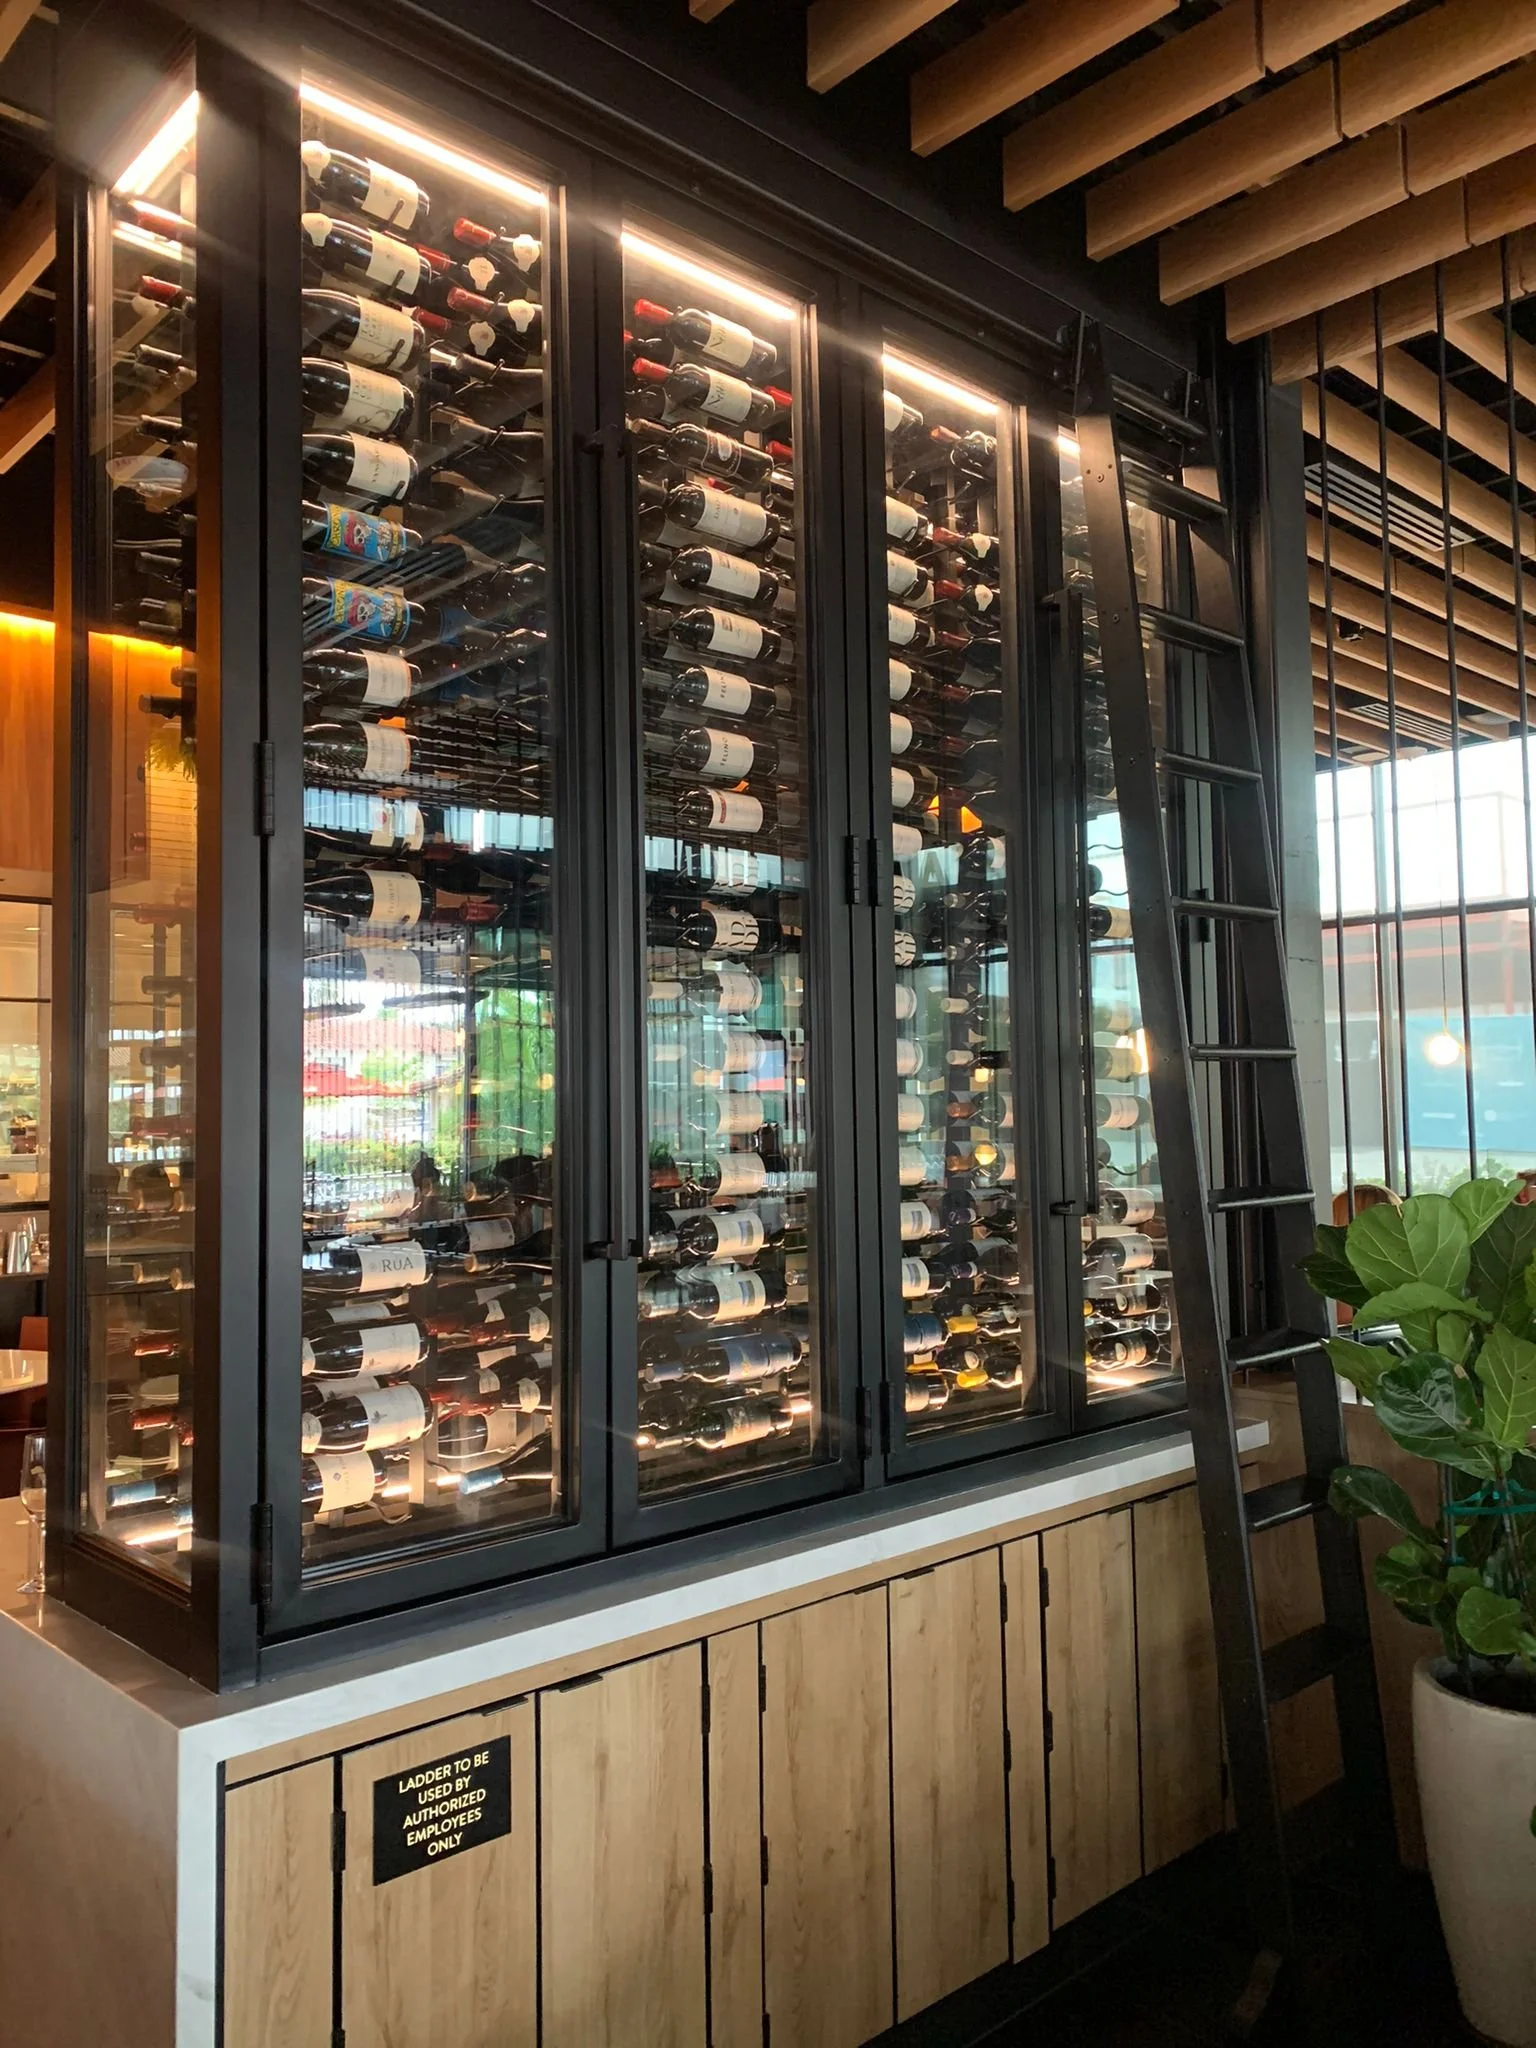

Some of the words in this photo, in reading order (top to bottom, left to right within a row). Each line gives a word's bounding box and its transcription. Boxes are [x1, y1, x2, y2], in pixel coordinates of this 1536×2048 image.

[382, 1256, 414, 1273] RUA
[398, 1764, 451, 1793] LADDER
[454, 1758, 471, 1773] TO
[474, 1751, 490, 1768] BE
[418, 1782, 452, 1805] USED
[455, 1775, 471, 1791] BY
[402, 1788, 486, 1829] AUTHORIZED
[407, 1807, 482, 1846] EMPLOYEES
[427, 1832, 463, 1856] ONLY
